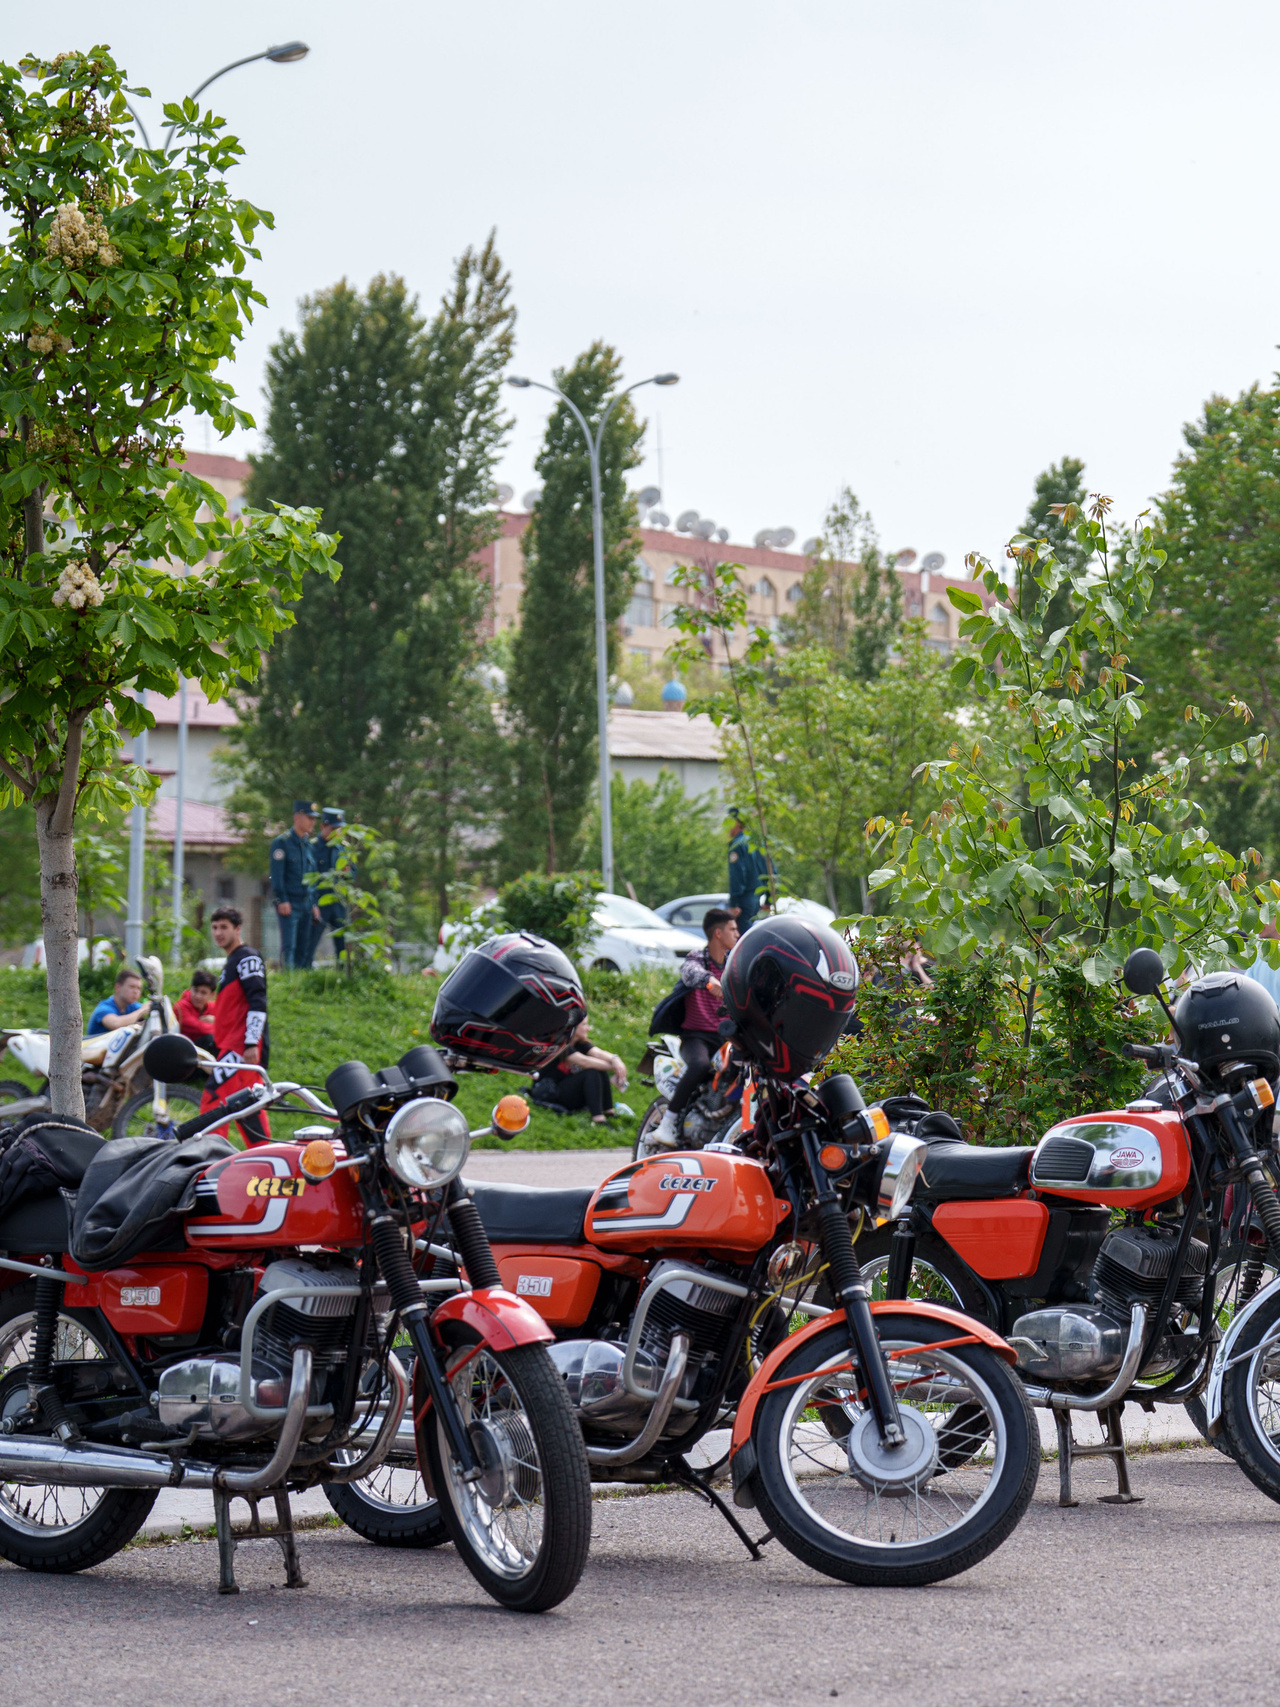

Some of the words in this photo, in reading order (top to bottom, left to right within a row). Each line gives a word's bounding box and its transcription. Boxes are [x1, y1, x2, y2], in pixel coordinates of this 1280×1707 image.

[1116, 1151, 1137, 1159] JAWA
[120, 1286, 161, 1306] 350
[517, 1276, 552, 1296] 350
